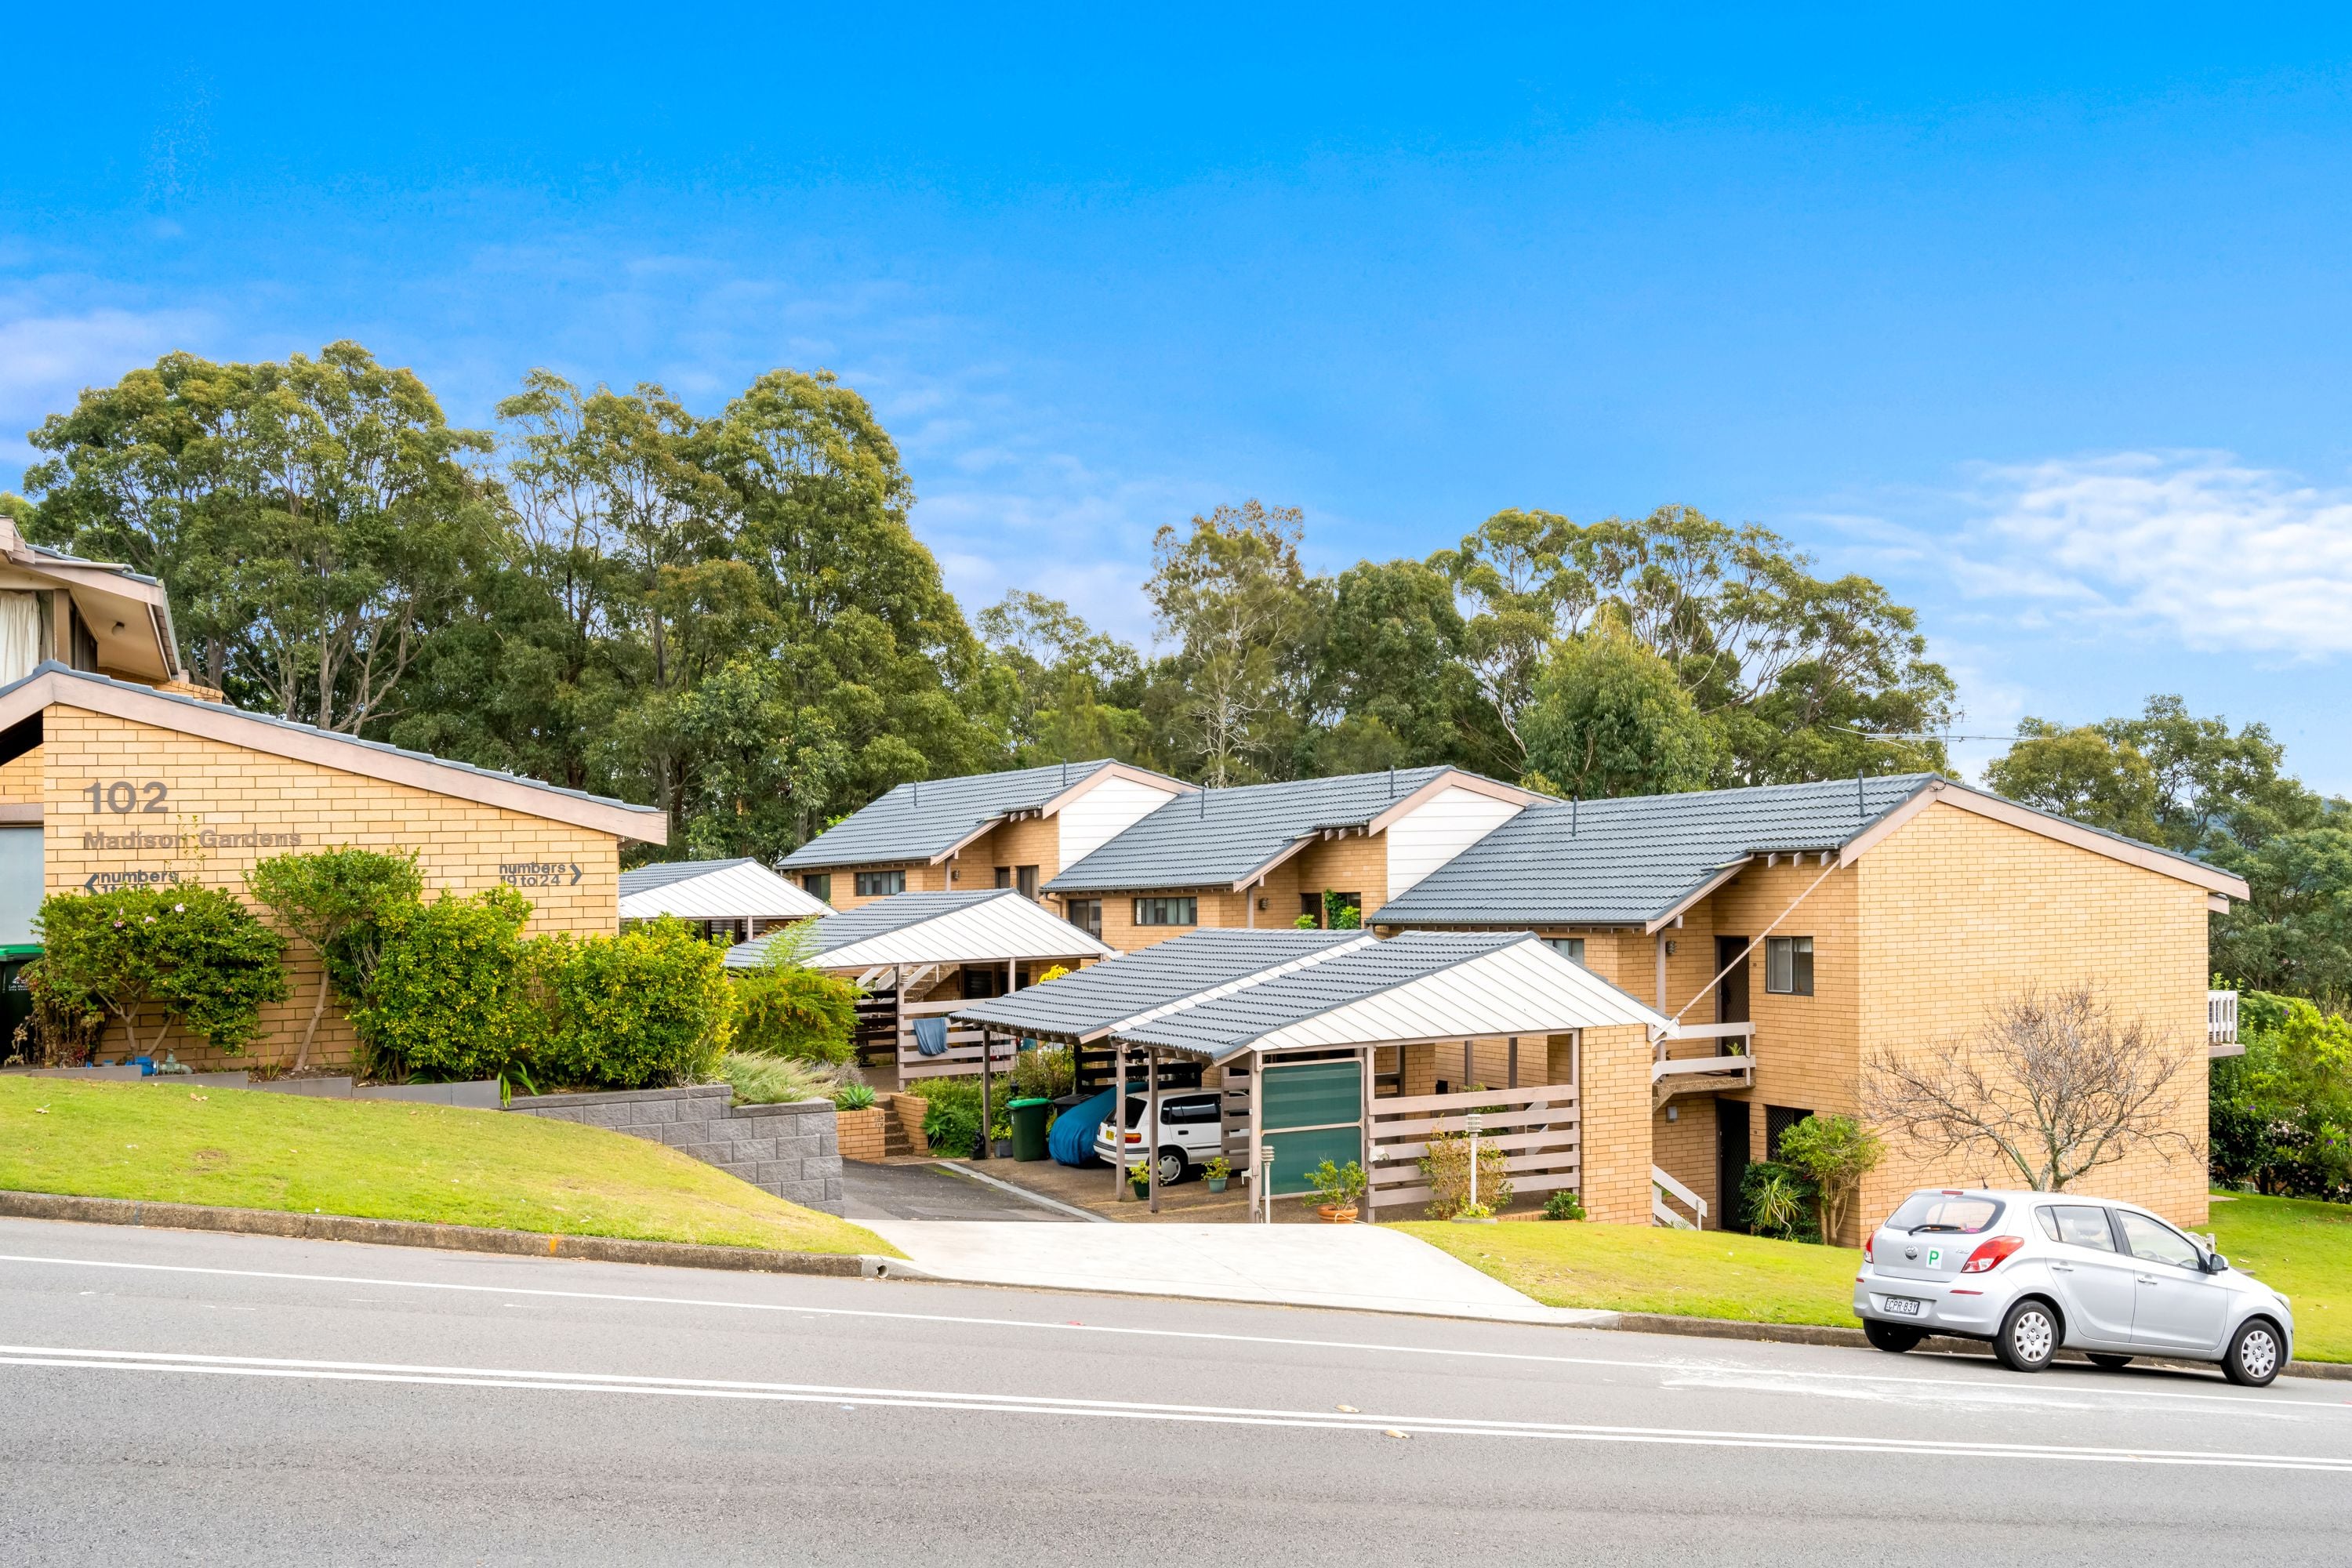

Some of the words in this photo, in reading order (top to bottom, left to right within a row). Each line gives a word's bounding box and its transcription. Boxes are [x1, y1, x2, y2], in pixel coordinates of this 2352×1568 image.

[85, 781, 169, 814] 102
[85, 831, 188, 849] Madison
[199, 829, 302, 848] Gardens
[499, 862, 566, 874] numbers
[101, 869, 178, 884] numbers
[521, 874, 536, 887] to
[540, 874, 561, 887] 24
[1929, 1250, 1939, 1265] P
